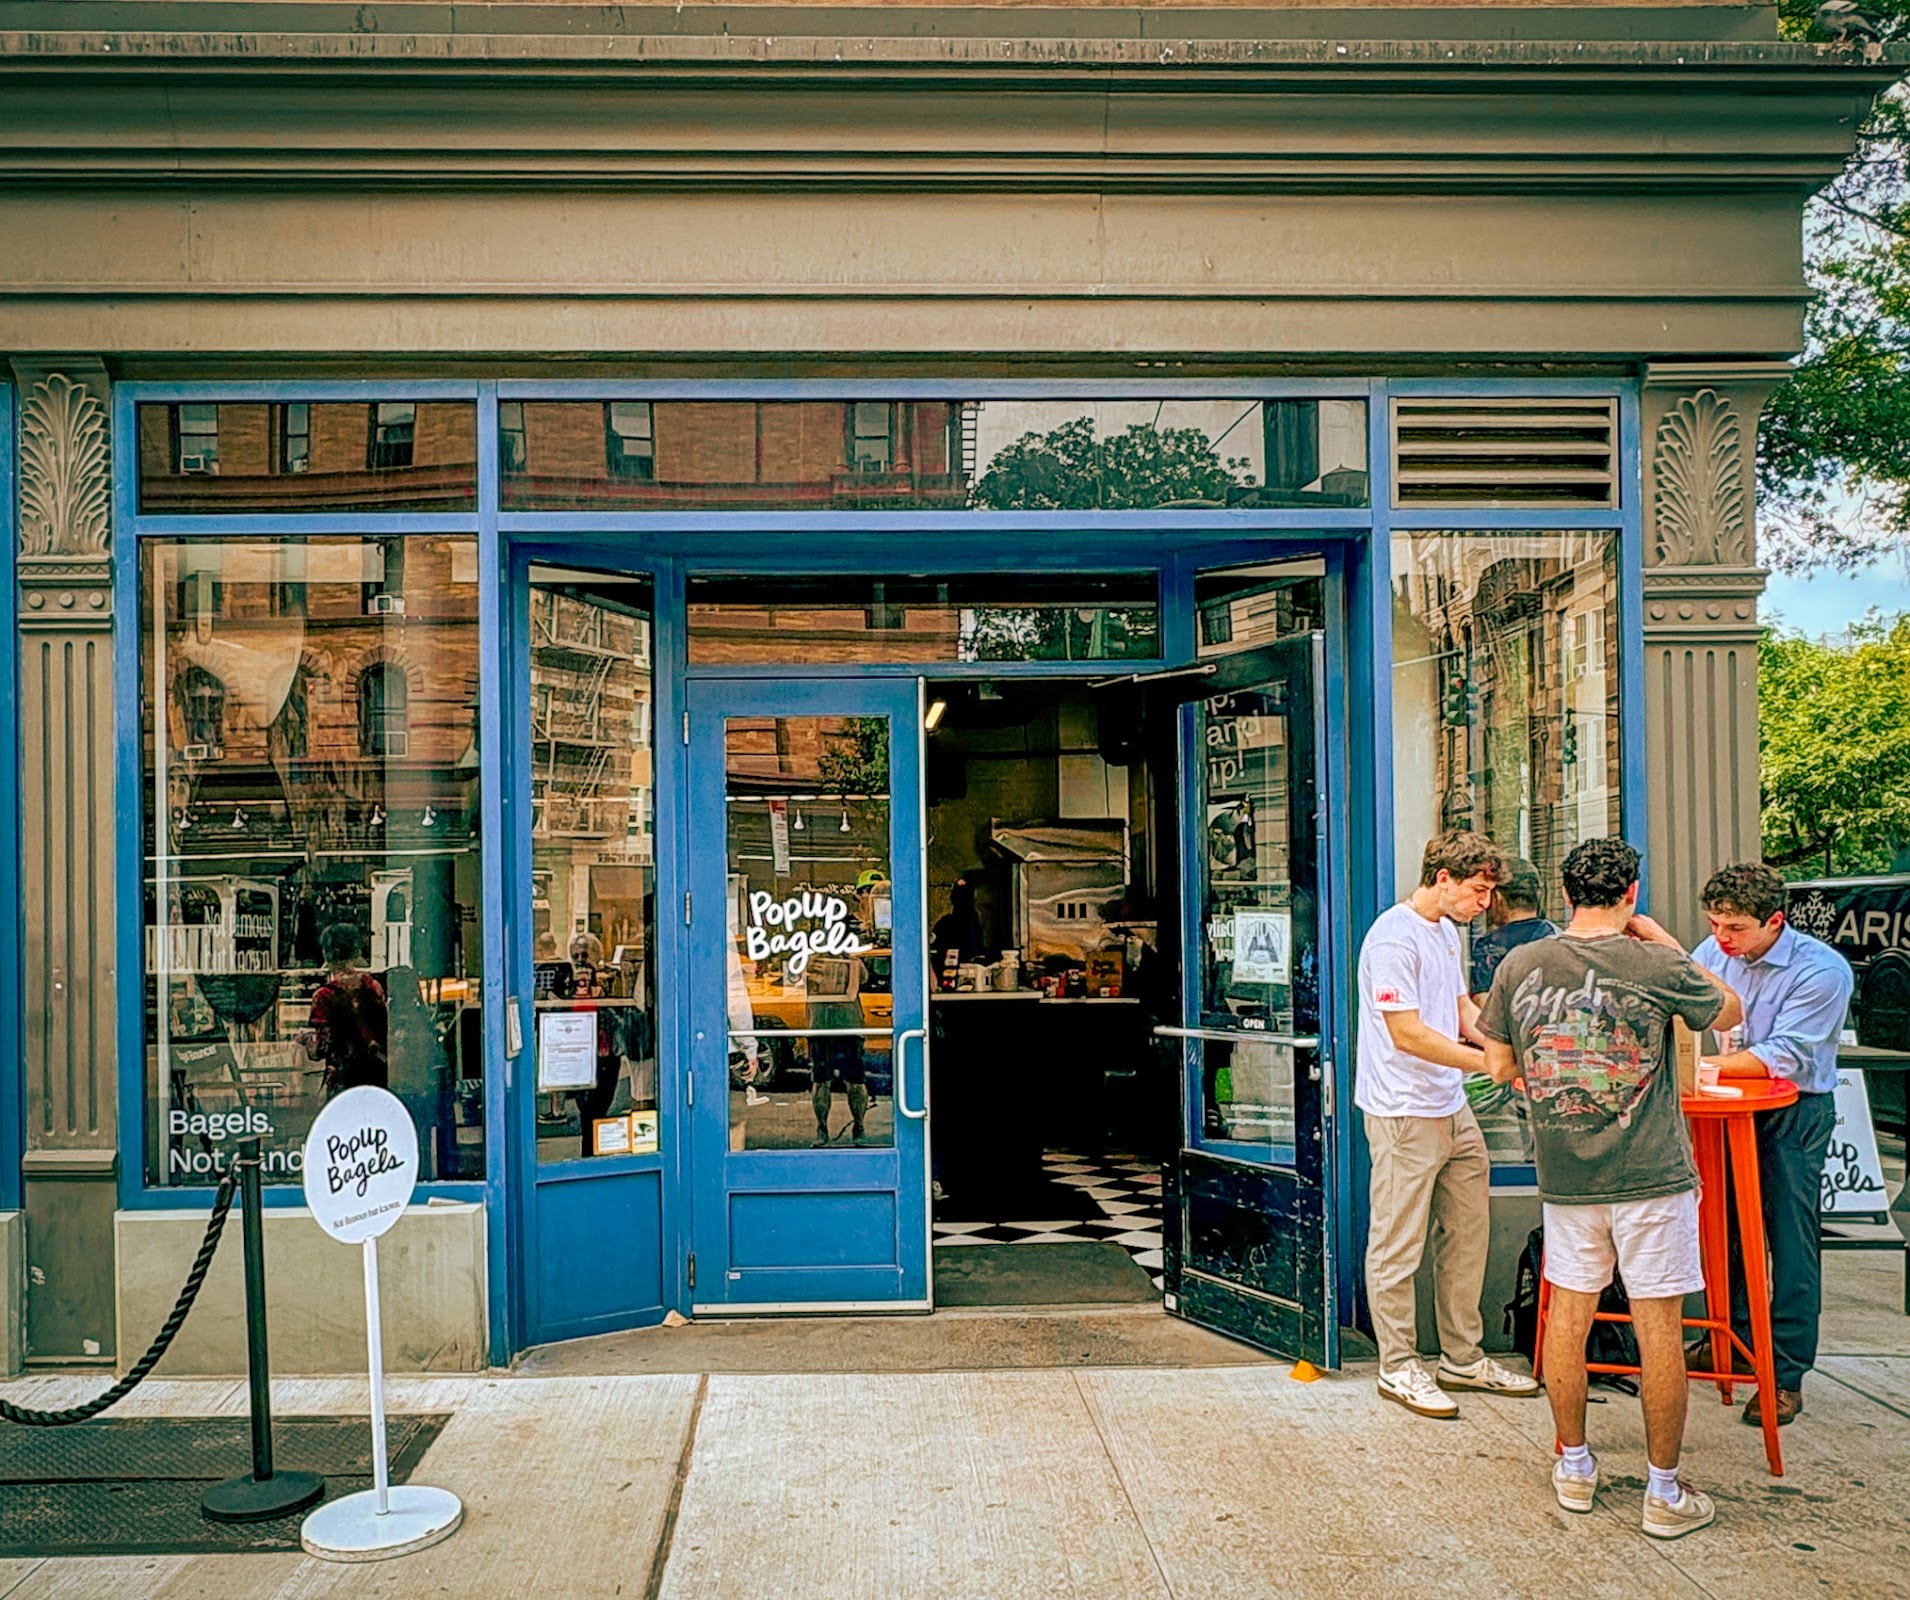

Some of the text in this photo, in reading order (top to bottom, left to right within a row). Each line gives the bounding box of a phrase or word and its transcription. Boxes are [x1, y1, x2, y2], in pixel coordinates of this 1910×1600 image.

[1206, 709, 1261, 746] and
[1208, 749, 1245, 789] ip!
[747, 921, 874, 974] Bagels
[1511, 967, 1650, 1040] Sydne
[169, 1106, 275, 1140] Bagels.
[169, 1148, 226, 1173] Not
[327, 1147, 405, 1197] Bagels
[1819, 1164, 1886, 1211] gels
